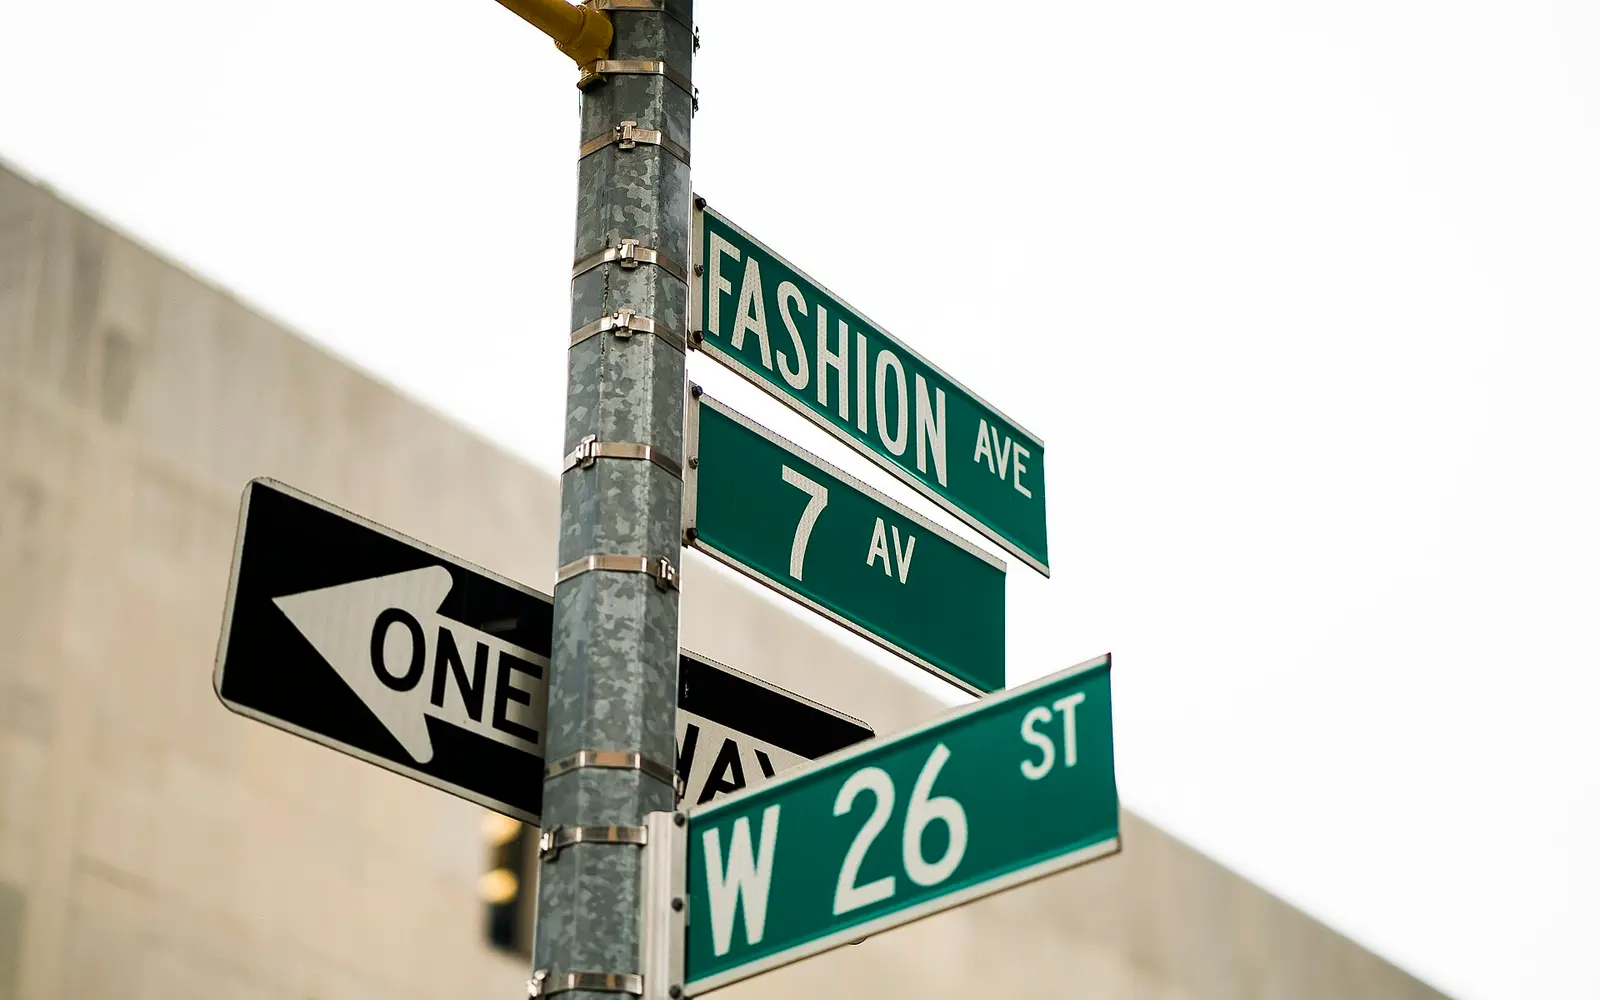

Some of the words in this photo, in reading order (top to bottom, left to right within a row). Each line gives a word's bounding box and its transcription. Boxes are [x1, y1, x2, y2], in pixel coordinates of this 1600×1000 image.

[708, 231, 947, 488] FASHION
[974, 419, 1032, 499] AVE
[782, 464, 829, 582] 7
[866, 517, 916, 584] AV
[370, 607, 543, 745] ONE
[702, 804, 780, 957] W
[833, 743, 968, 917] 26
[1020, 692, 1086, 780] ST
